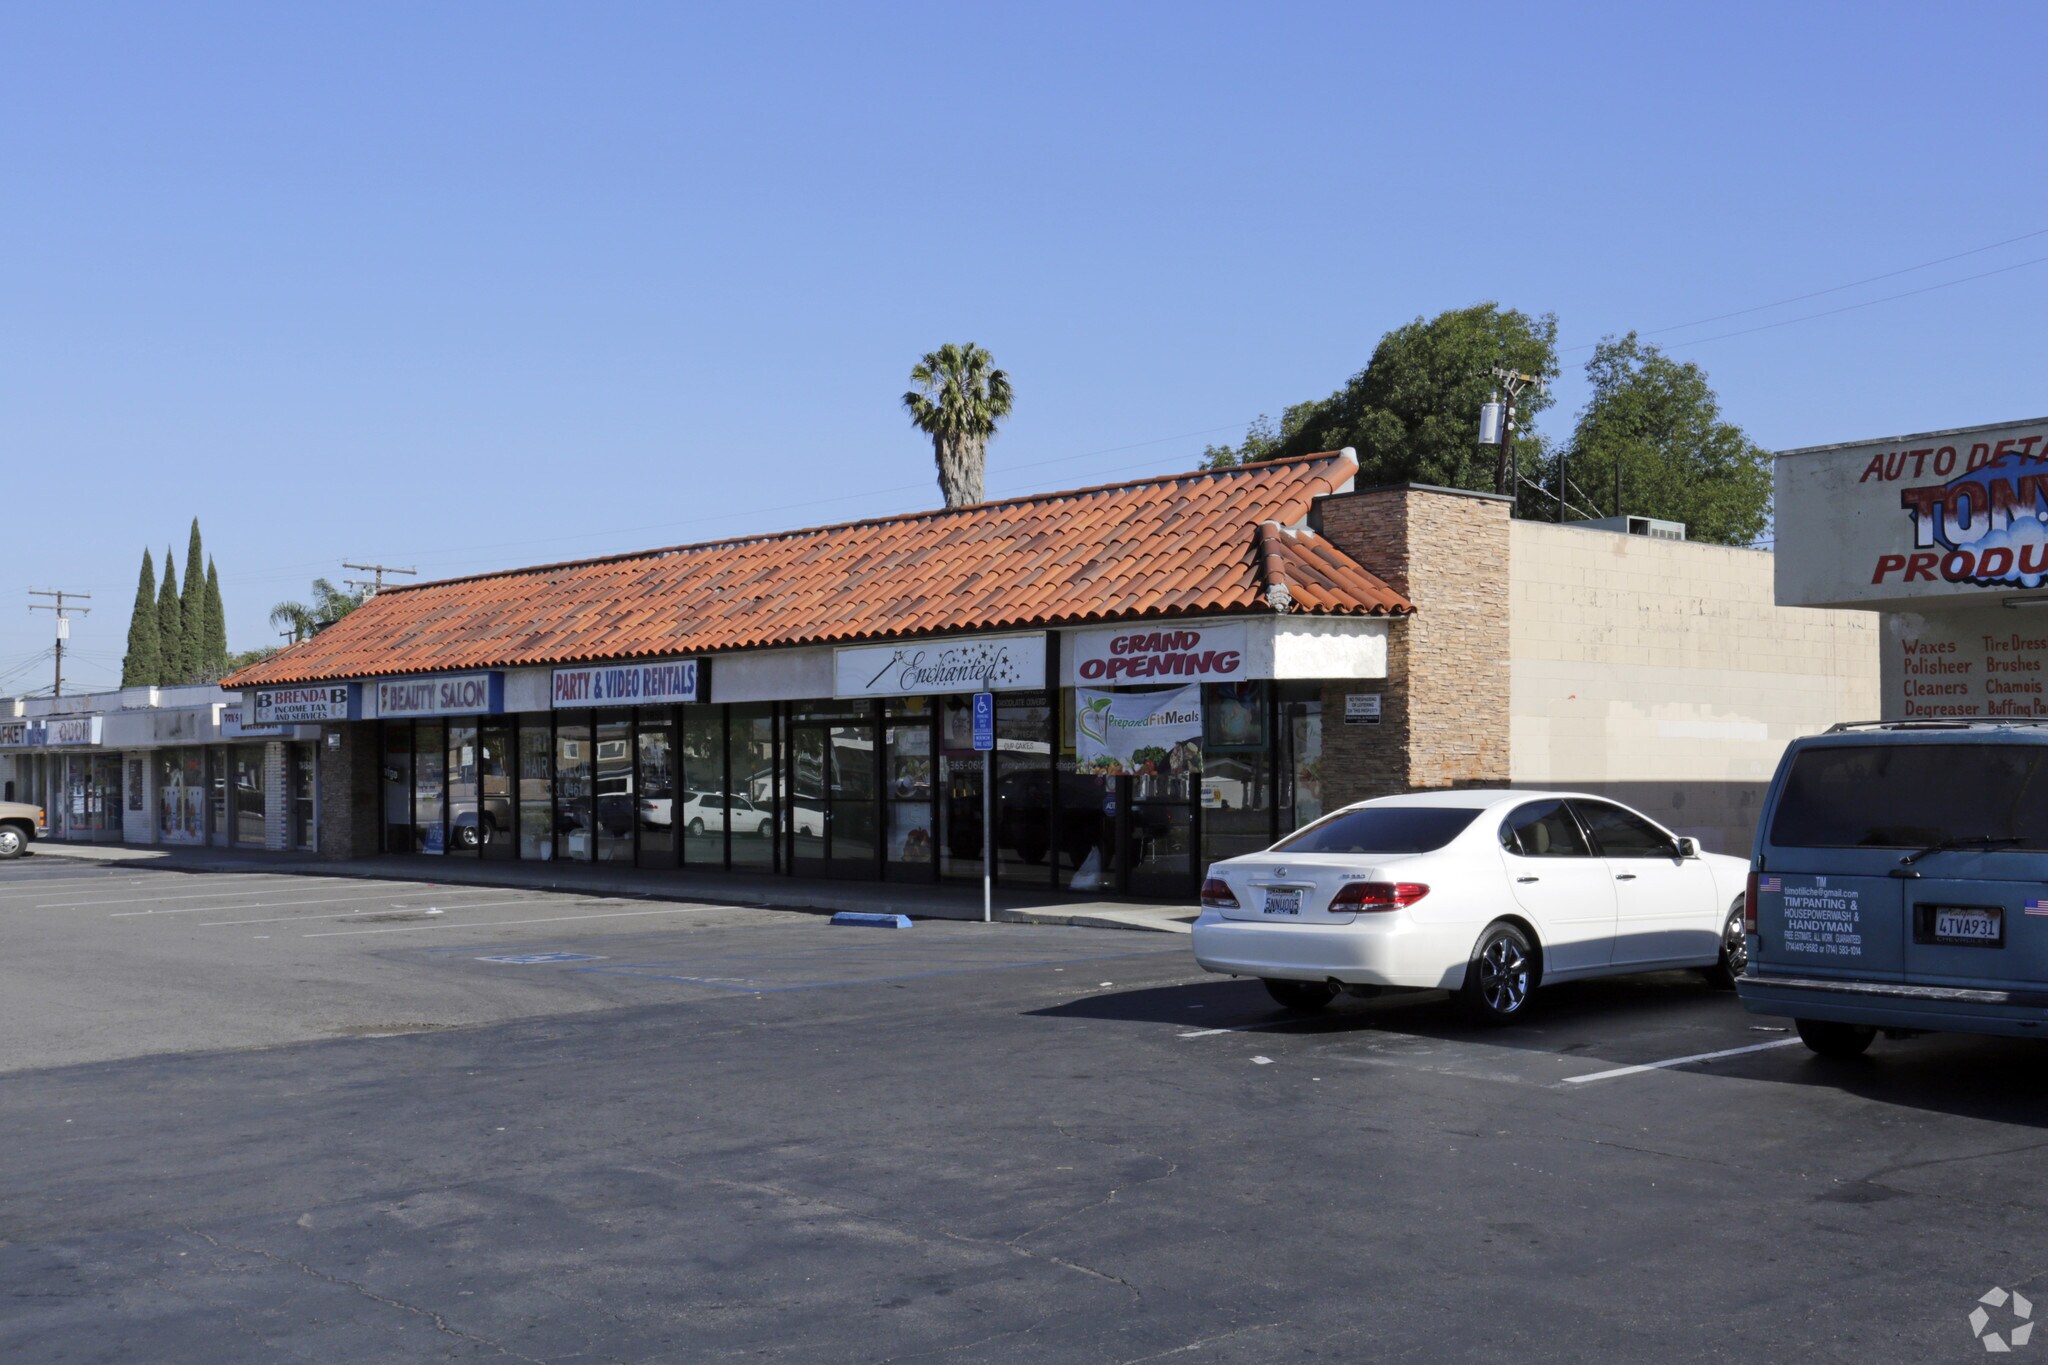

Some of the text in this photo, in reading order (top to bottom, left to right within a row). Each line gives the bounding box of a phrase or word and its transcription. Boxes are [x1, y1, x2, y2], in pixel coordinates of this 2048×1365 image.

[1859, 446, 1956, 483] AUTO
[1109, 630, 1200, 655] GRAND
[1902, 639, 1956, 655] Waxes
[1982, 635, 2009, 651] Tire
[900, 647, 1007, 690] Enchanted
[1079, 651, 1240, 679] OPENING
[1903, 656, 1972, 675] Polisheer
[1986, 654, 2040, 672] Brushes
[555, 664, 695, 701] PARTY & VIDEO RENTALS
[1903, 679, 1968, 697] Cleaners
[1985, 678, 2043, 694] Chamois
[274, 689, 327, 704] BRENDA
[390, 680, 487, 711] BEAUTY SALON
[275, 703, 328, 714] INCOME TAX
[1905, 700, 1980, 718] Degreaser
[1988, 697, 2048, 717] Buffing Pa
[274, 712, 328, 721] AND SERVICES
[1816, 876, 1827, 888] TIM
[1850, 900, 1858, 910] &
[1784, 908, 1860, 922] HOUSEPOWERWASH &
[1788, 919, 1853, 933] HANDYMAN
[1939, 918, 1995, 936] 4TVA931
